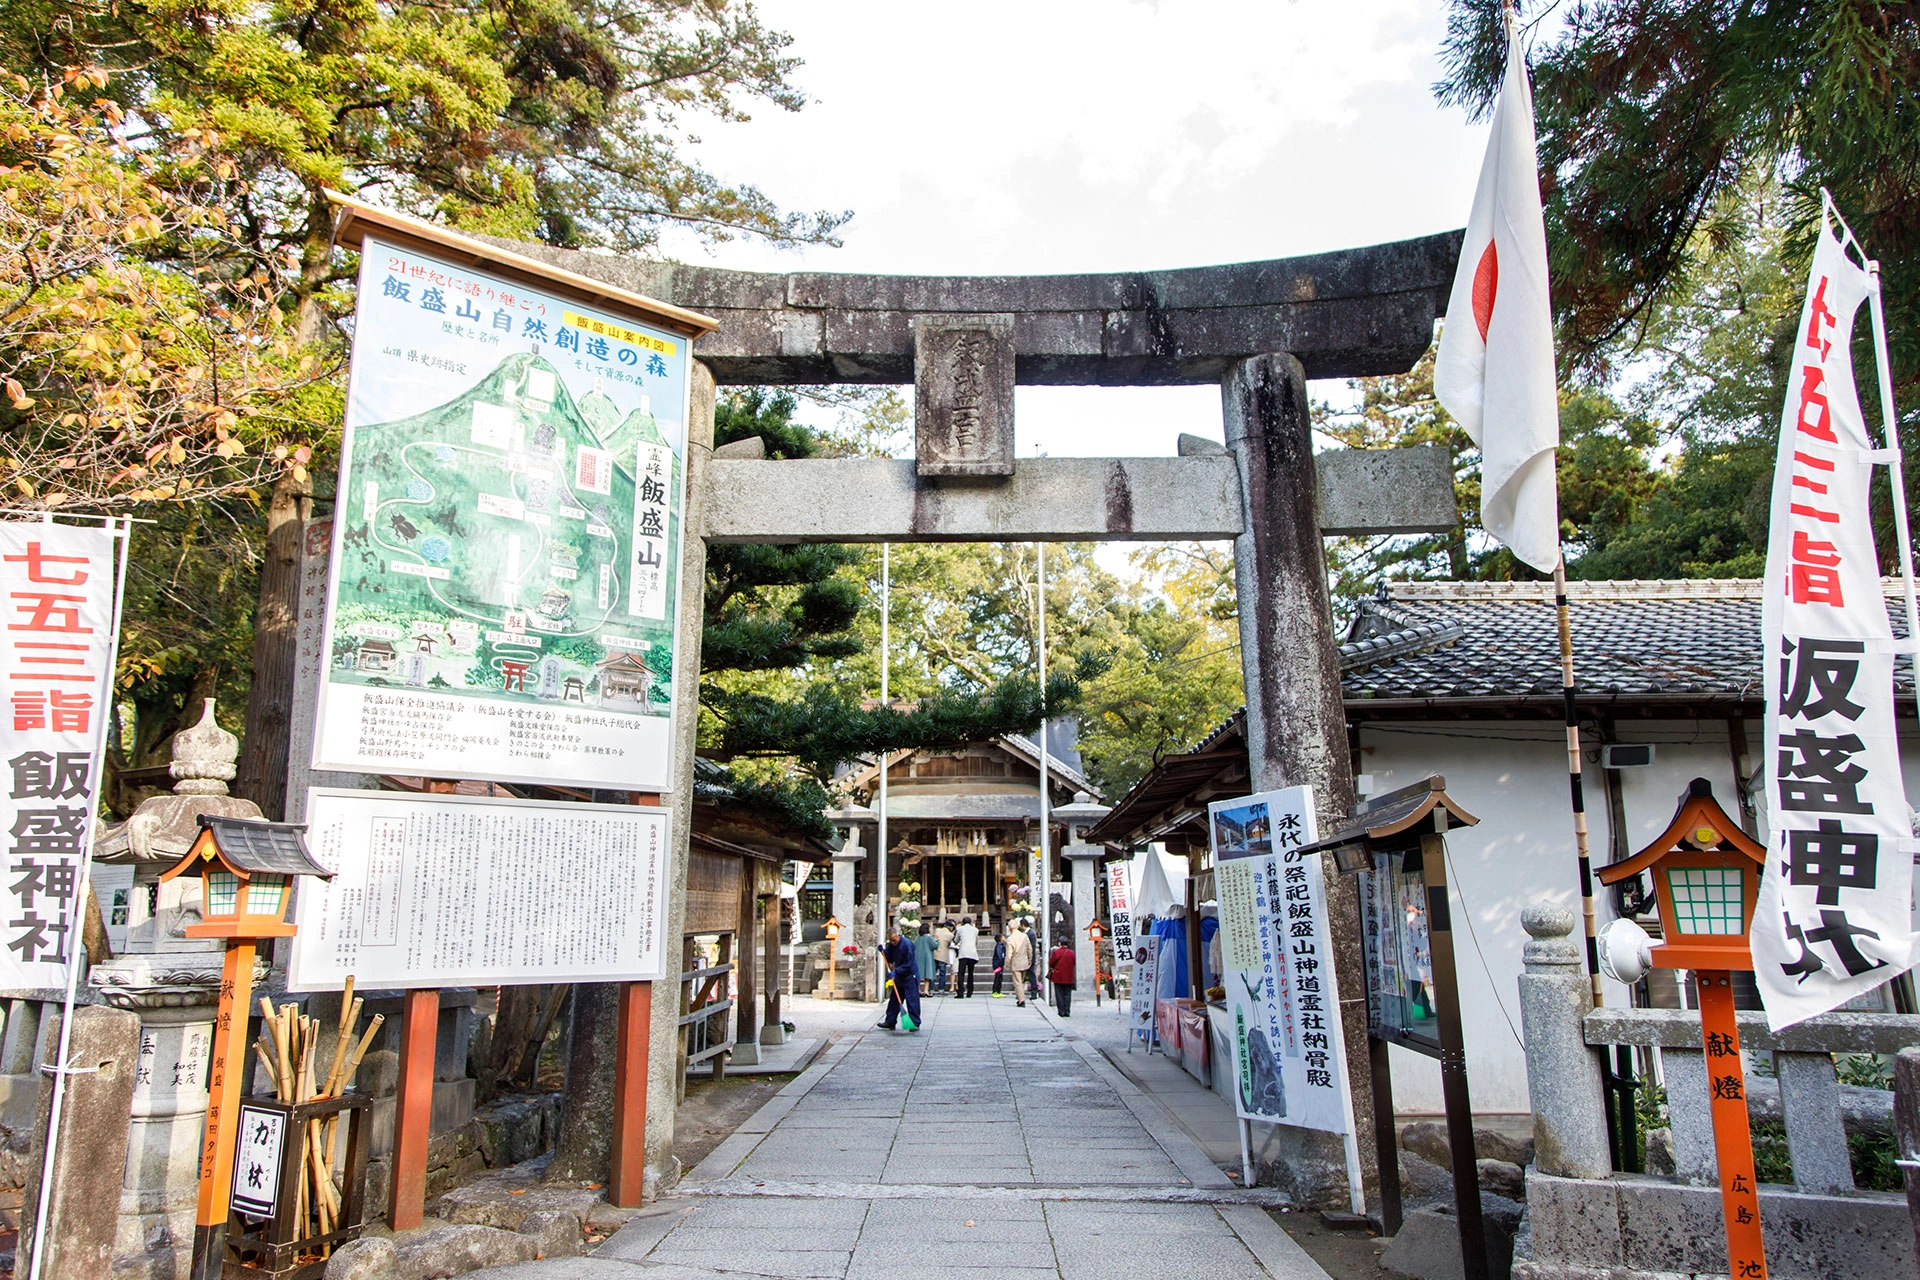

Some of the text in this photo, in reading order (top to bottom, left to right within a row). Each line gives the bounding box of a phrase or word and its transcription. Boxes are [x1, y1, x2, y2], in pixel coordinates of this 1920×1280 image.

[382, 274, 668, 378] 飯盛山自然創造の森
[388, 257, 547, 316] 21世紀に語り継ごう
[442, 321, 500, 346] 歴史と名所
[575, 359, 645, 388] そして資源の森
[577, 316, 664, 352] 飯盛山案内図
[637, 475, 666, 569] 飯盛山
[508, 615, 523, 629] 駐
[3, 541, 96, 965] 七五三詣 飯盛神社
[1110, 867, 1134, 961] 七五三詣 飯盛神社
[1278, 813, 1334, 1088] 永代の祭祀飯盛山神道霊社納骨殿
[1706, 1031, 1743, 1100] 献燈
[1731, 1174, 1754, 1225] 広島
